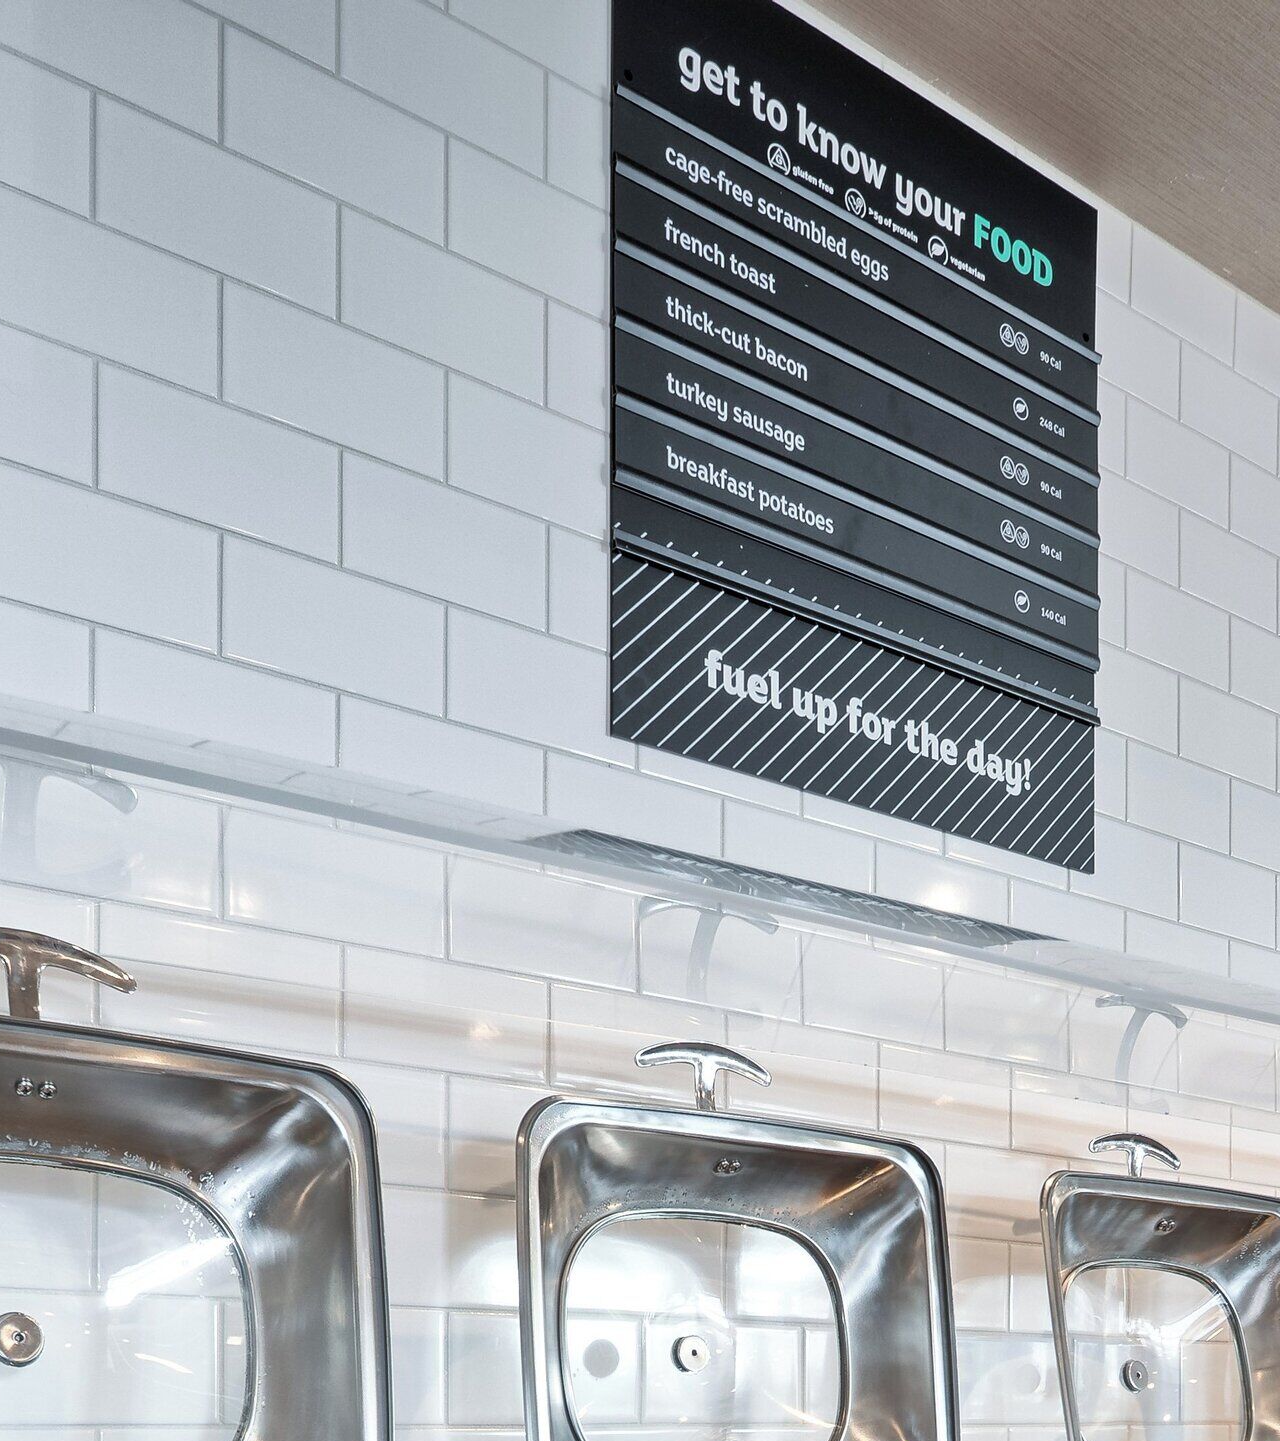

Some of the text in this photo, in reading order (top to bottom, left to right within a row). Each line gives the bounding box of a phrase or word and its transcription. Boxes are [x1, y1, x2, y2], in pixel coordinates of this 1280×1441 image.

[678, 47, 1054, 288] get to know your FOOD
[664, 145, 889, 282] cage-free scrambled eggs
[792, 165, 818, 187] gluten
[818, 179, 834, 195] free
[884, 216, 892, 228] of
[892, 220, 919, 243] protein
[950, 255, 987, 282] vegetarian
[664, 218, 776, 294] french toast
[665, 296, 808, 382] thick-cut bacon
[1039, 350, 1062, 371] 90 Cal
[666, 372, 806, 452] turkey sausage
[1053, 424, 1065, 438] Cal
[666, 445, 835, 535] breakfast potatoes
[1040, 481, 1062, 500] 90 Cal
[1040, 543, 1062, 562] 90 Cal
[1041, 607, 1067, 626] 140 Cal
[704, 649, 1031, 796] fuel up for the day!
